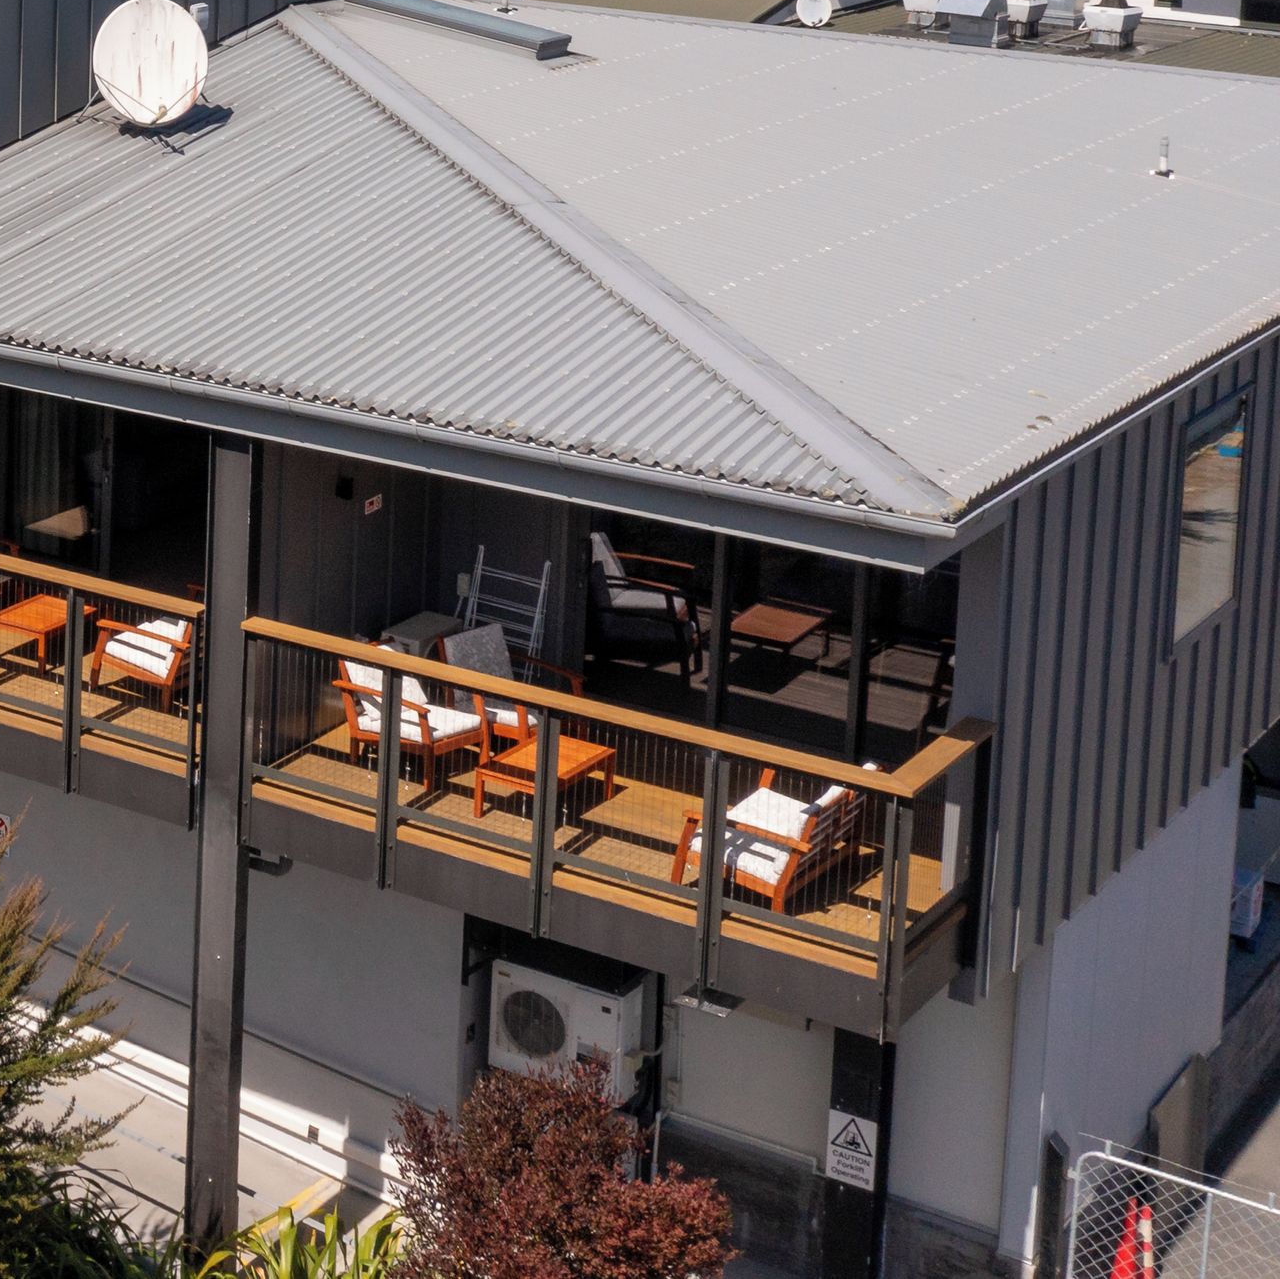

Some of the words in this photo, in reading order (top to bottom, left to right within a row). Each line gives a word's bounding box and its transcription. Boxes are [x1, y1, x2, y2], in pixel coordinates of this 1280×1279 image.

[832, 1149, 870, 1167] CAUTION
[836, 1159, 865, 1174] Forklift
[831, 1166, 870, 1185] Operating
